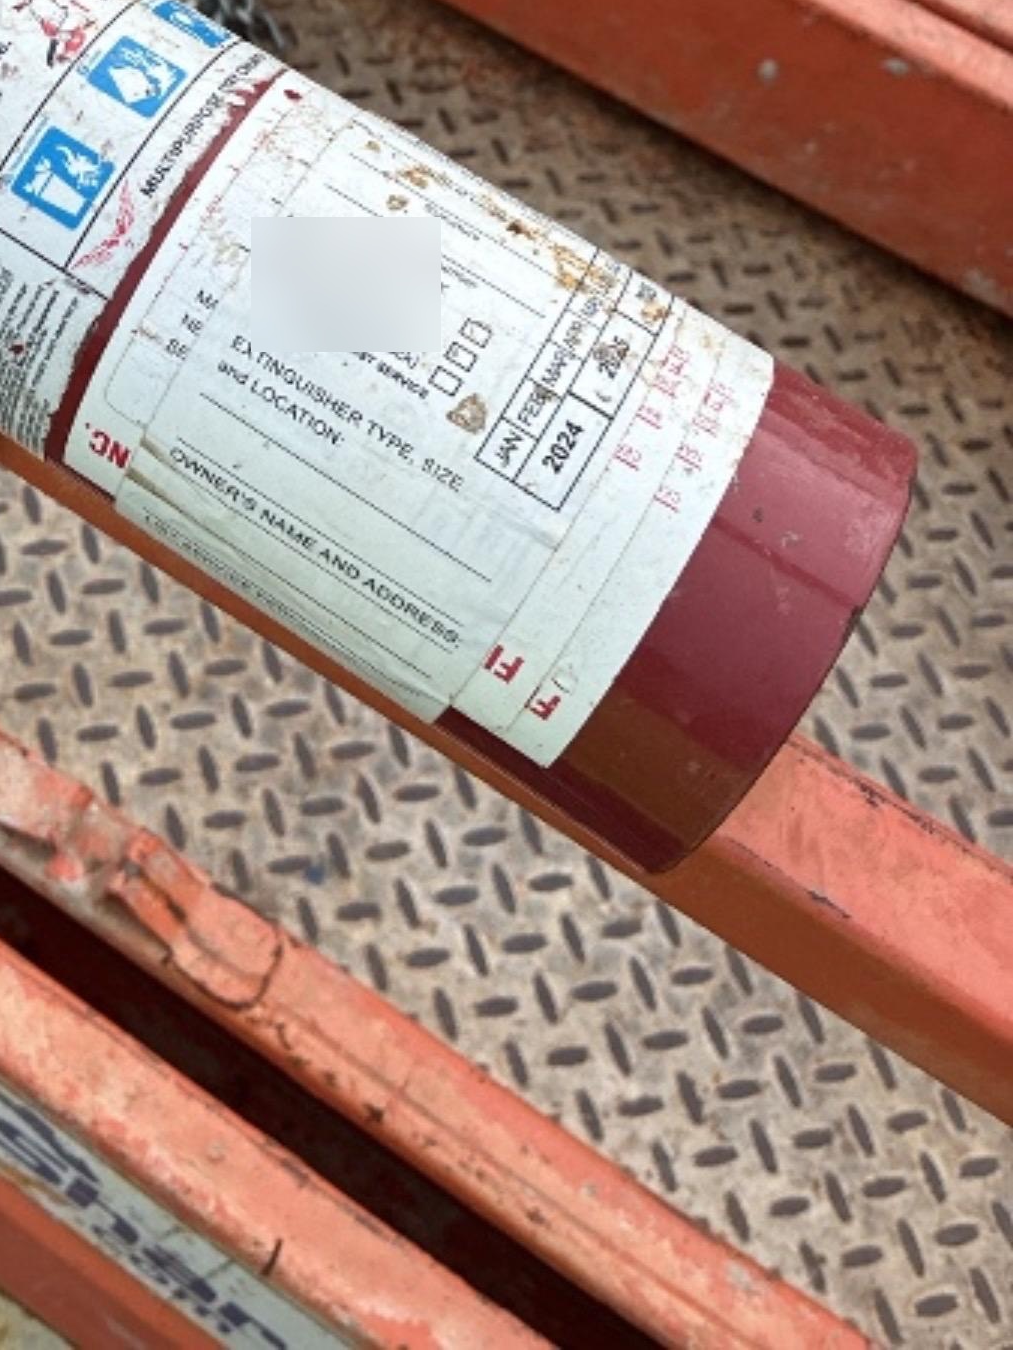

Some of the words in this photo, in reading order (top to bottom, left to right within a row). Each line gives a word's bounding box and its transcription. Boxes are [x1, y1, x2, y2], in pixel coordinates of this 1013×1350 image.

[216, 358, 249, 386] and
[248, 378, 346, 449] LOCATION:
[375, 360, 429, 400] SERVICE
[490, 428, 524, 468] JAN
[540, 347, 573, 387] MAR
[362, 418, 419, 466] TYPE,
[419, 456, 465, 493] SIZE
[539, 418, 584, 475] 2024
[167, 444, 259, 513] OWNER'S
[258, 507, 318, 553] NAME
[317, 545, 362, 581] AND
[360, 574, 464, 649] ADDRESS:
